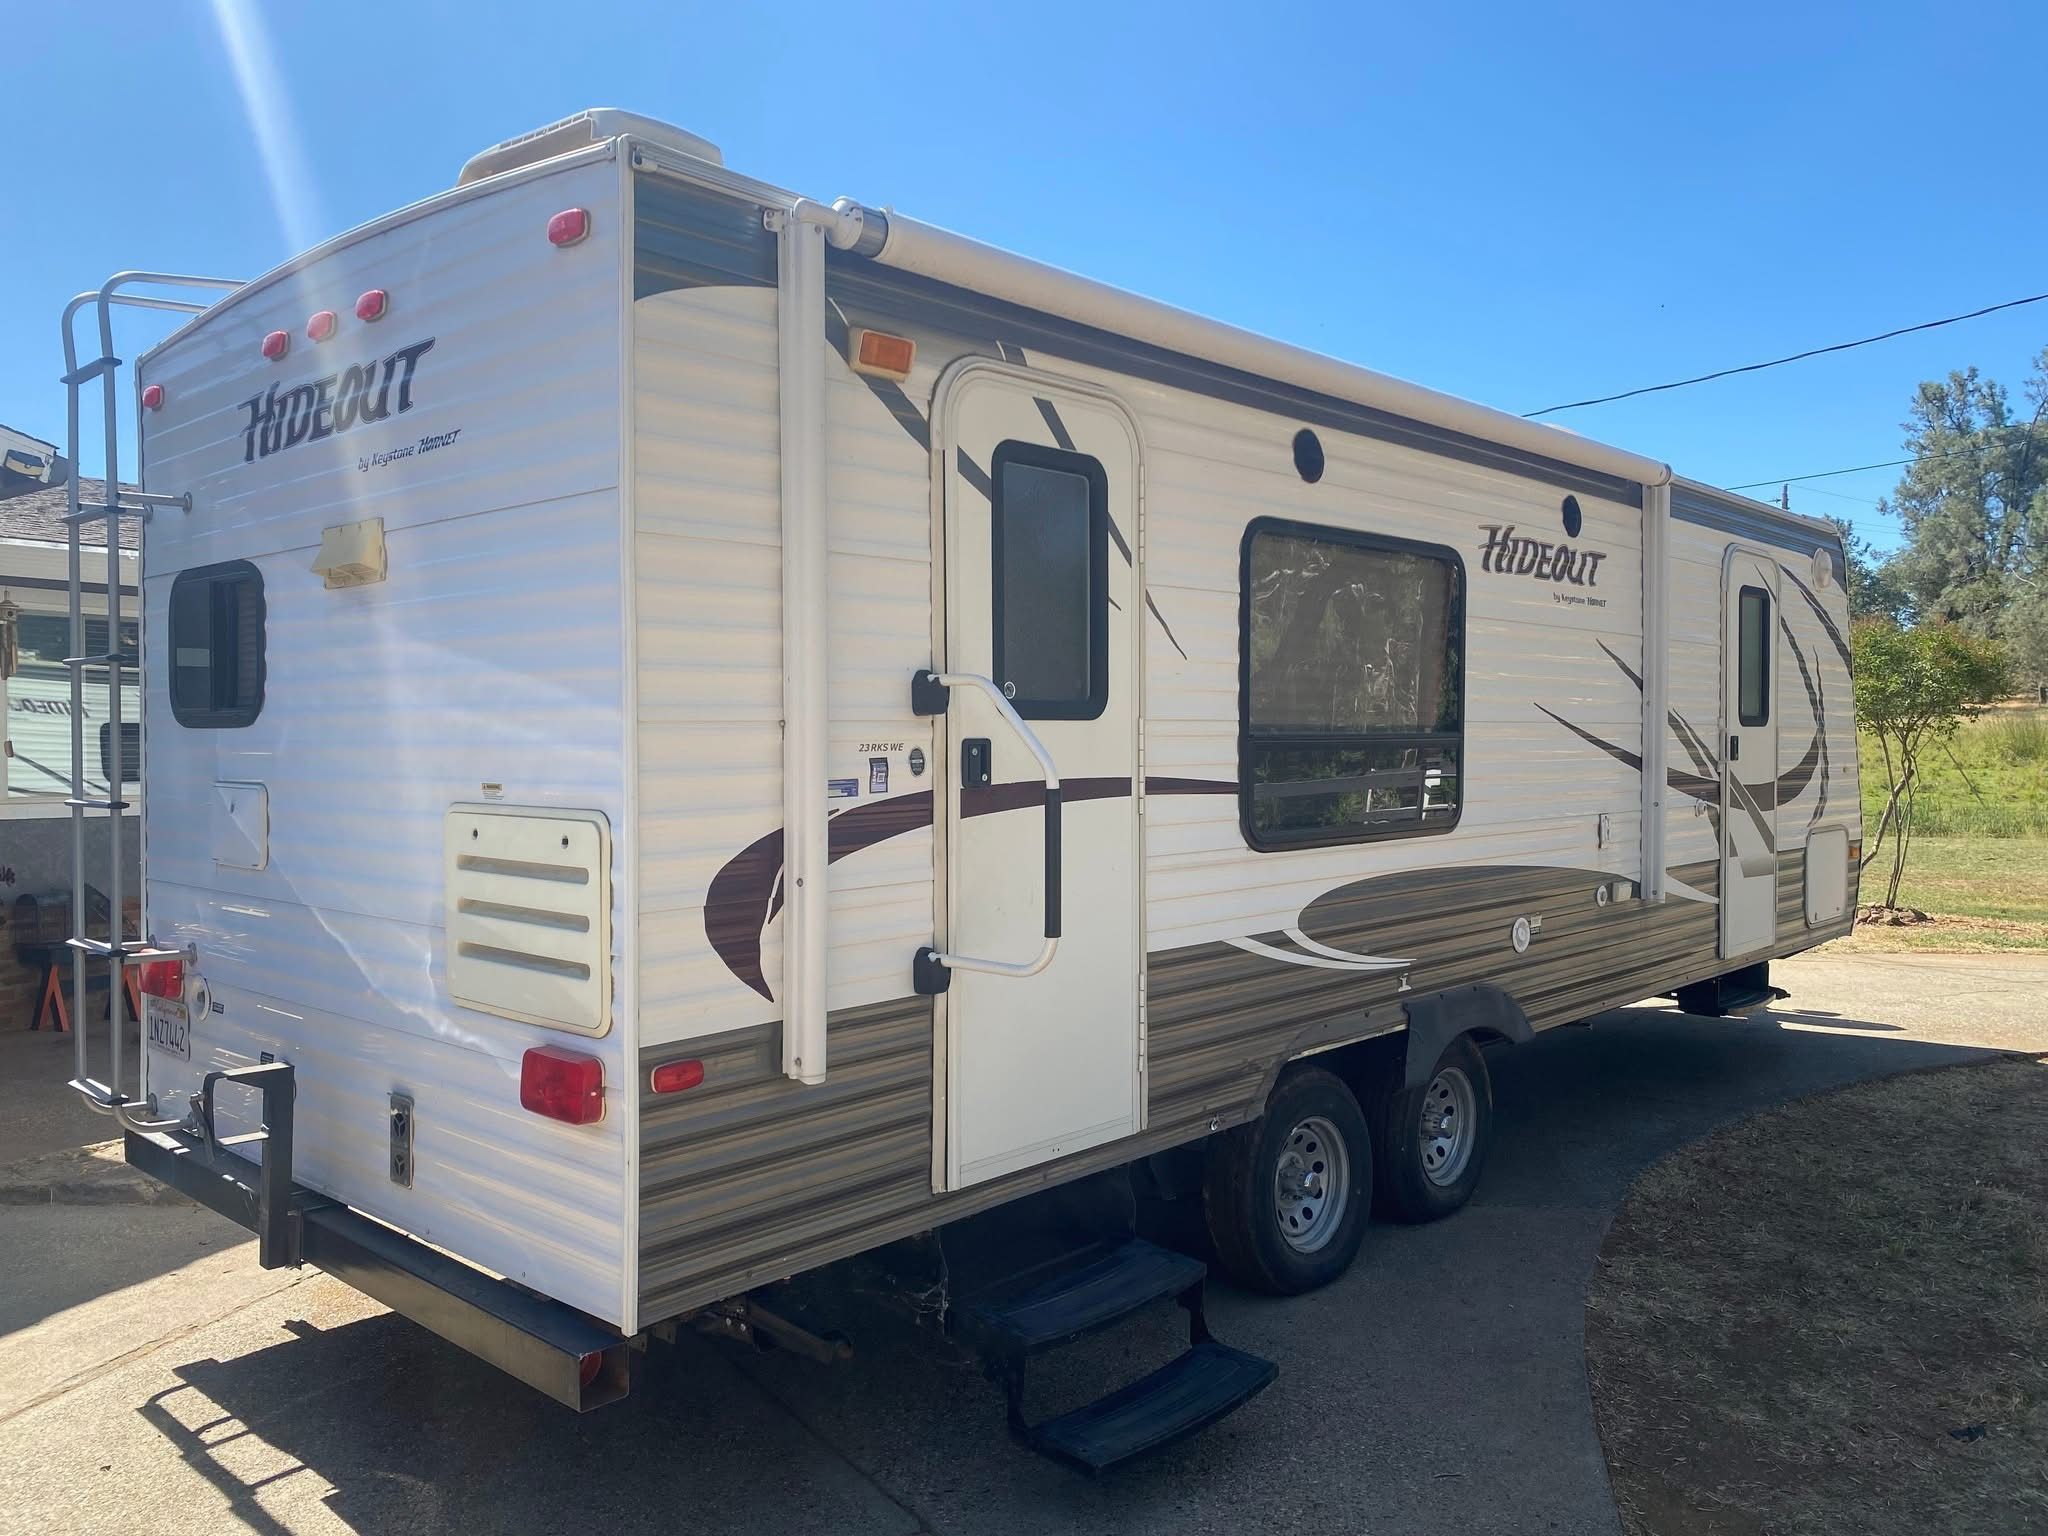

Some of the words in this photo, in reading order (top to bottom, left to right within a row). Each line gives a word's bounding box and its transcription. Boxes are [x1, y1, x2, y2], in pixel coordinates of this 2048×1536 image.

[237, 337, 435, 464] HIDEOUT
[358, 456, 369, 472] by
[371, 446, 415, 467] Keystone
[1478, 525, 1607, 587] HIDEOUT
[1553, 592, 1560, 603] by
[890, 742, 904, 751] WE
[149, 1015, 185, 1052] 1NZ7442
